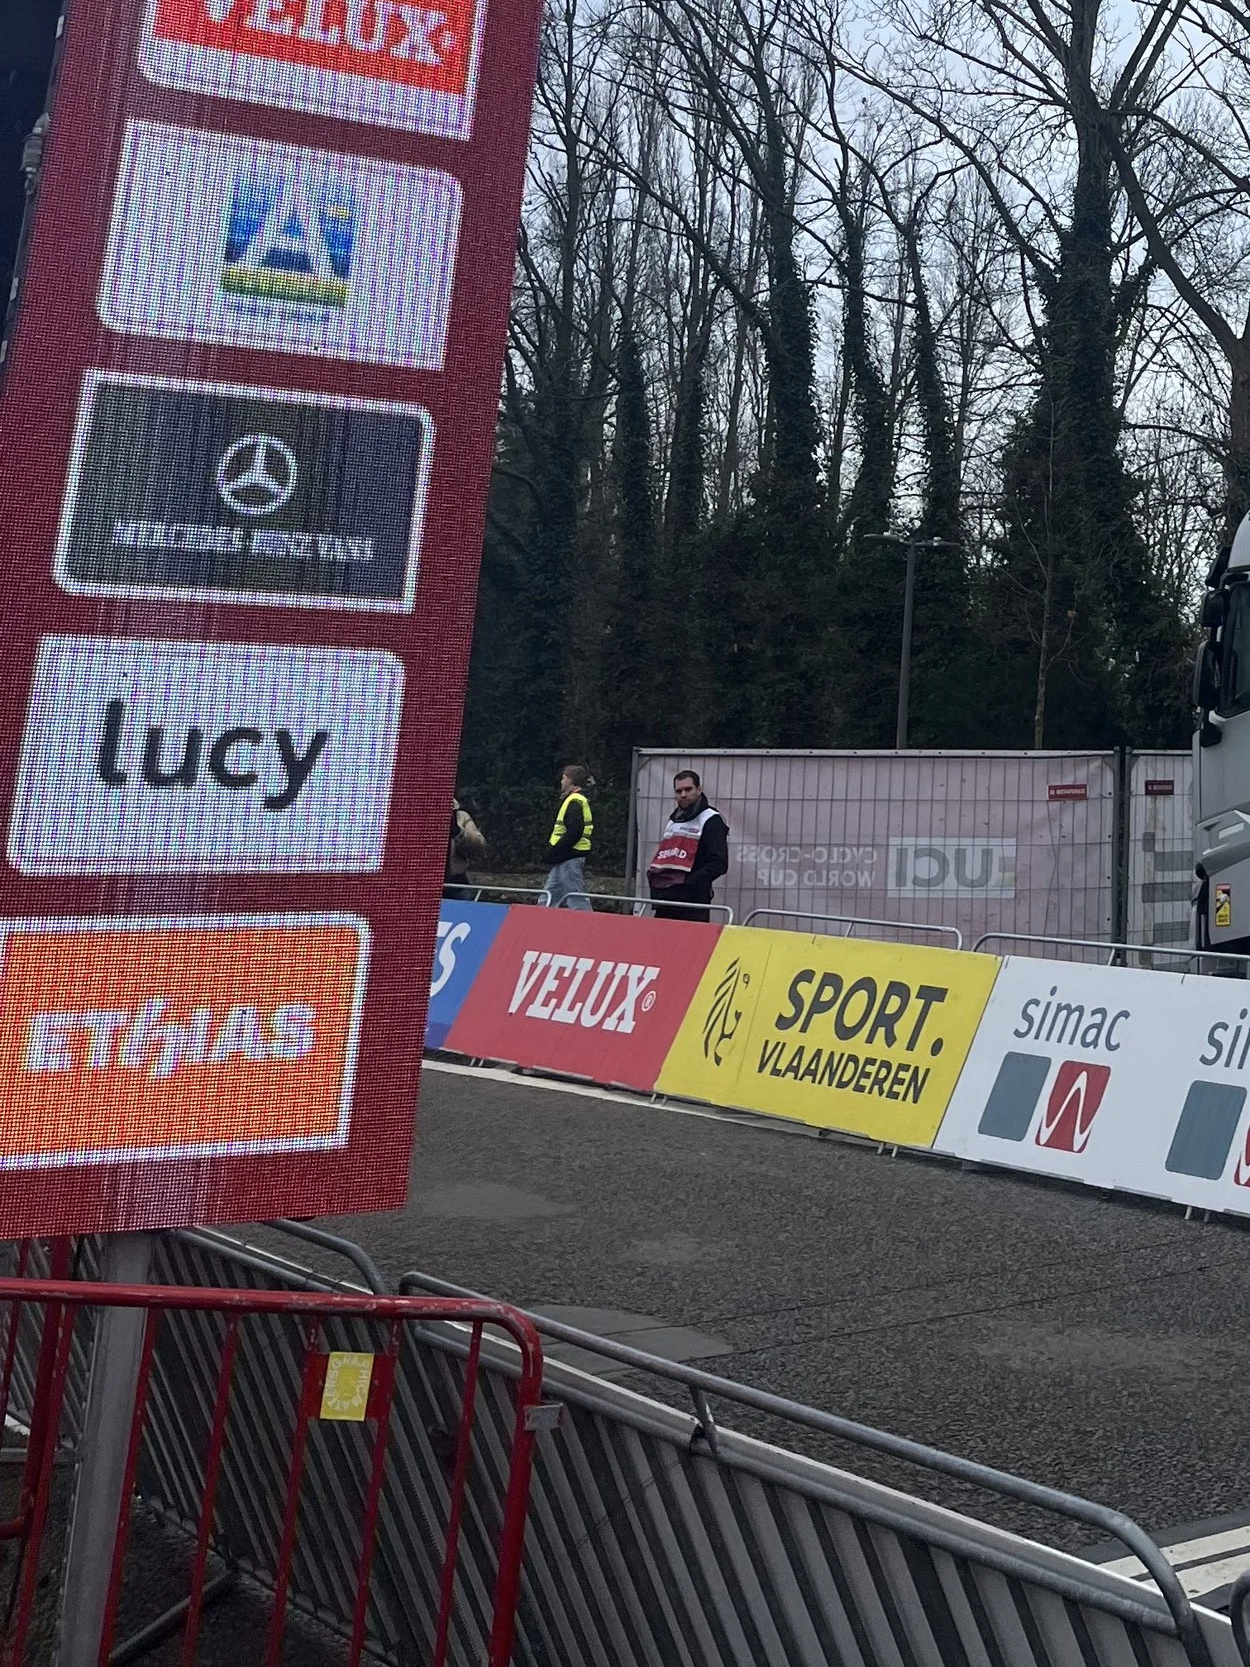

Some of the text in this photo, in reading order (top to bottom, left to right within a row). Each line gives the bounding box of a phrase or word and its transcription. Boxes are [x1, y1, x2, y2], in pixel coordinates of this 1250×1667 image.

[98, 698, 328, 811] lucy
[1014, 986, 1131, 1052] simac
[757, 1038, 931, 1105] VLAANDEREN
